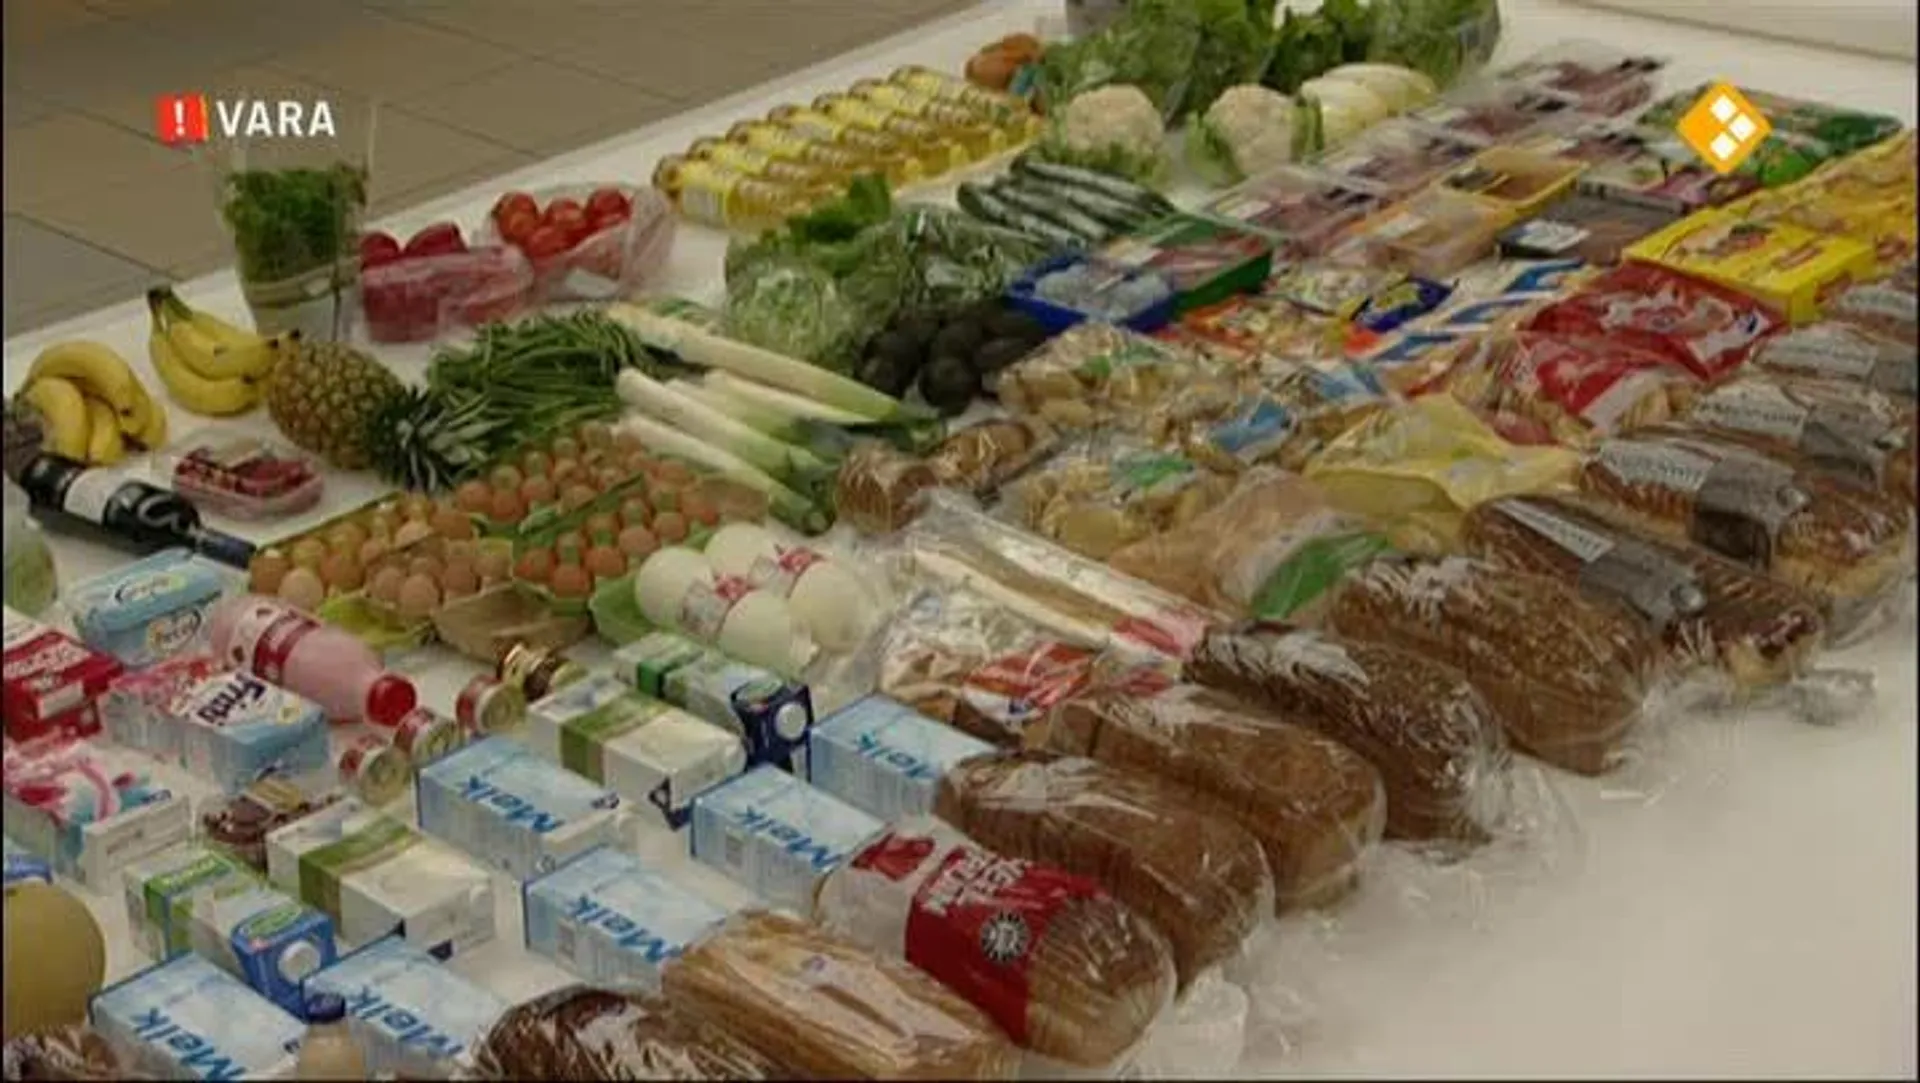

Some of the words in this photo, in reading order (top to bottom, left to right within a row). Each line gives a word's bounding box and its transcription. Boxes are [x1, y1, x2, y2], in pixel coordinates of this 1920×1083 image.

[458, 775, 565, 833] Melk
[733, 805, 843, 872] Melk
[570, 894, 684, 963] Melk
[130, 1008, 247, 1080] Melk
[346, 986, 464, 1056] Melk
